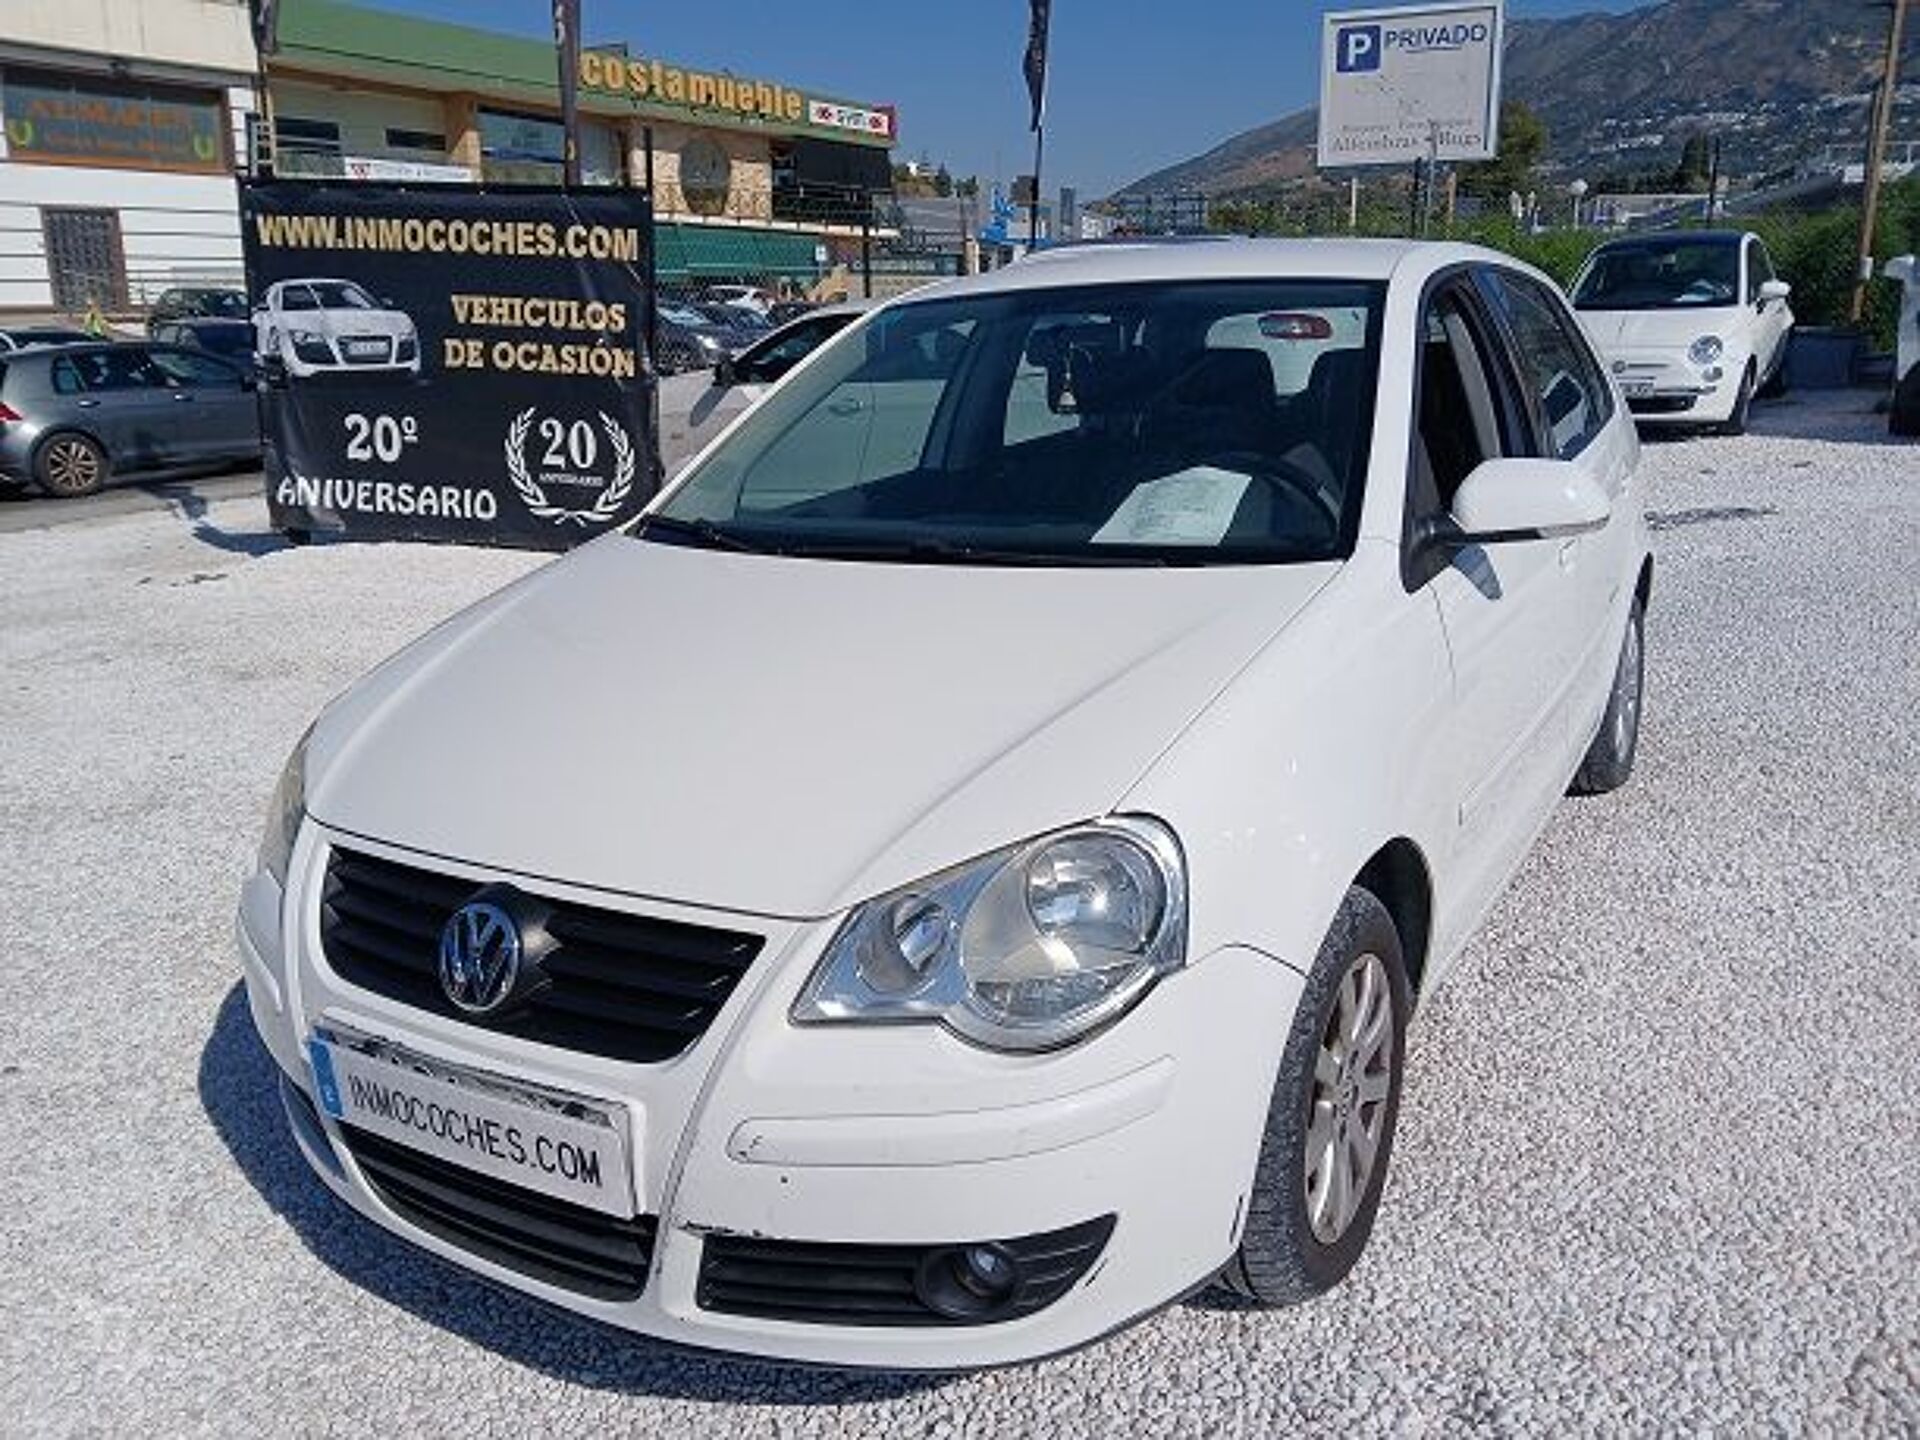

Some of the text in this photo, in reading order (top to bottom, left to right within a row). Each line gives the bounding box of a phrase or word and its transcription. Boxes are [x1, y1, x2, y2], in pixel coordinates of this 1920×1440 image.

[1348, 24, 1488, 67] P PRIVADO
[580, 51, 802, 121] costamueble
[256, 214, 639, 261] WWW.INMOCOCHES.COM
[451, 294, 626, 333] VEHICULOS
[444, 337, 635, 378] DE OCASIÓN
[344, 413, 419, 462] 20º
[539, 417, 597, 469] 20
[276, 474, 498, 520] ANIVERSARIO
[348, 1074, 603, 1188] INMOCOCHES.COM
